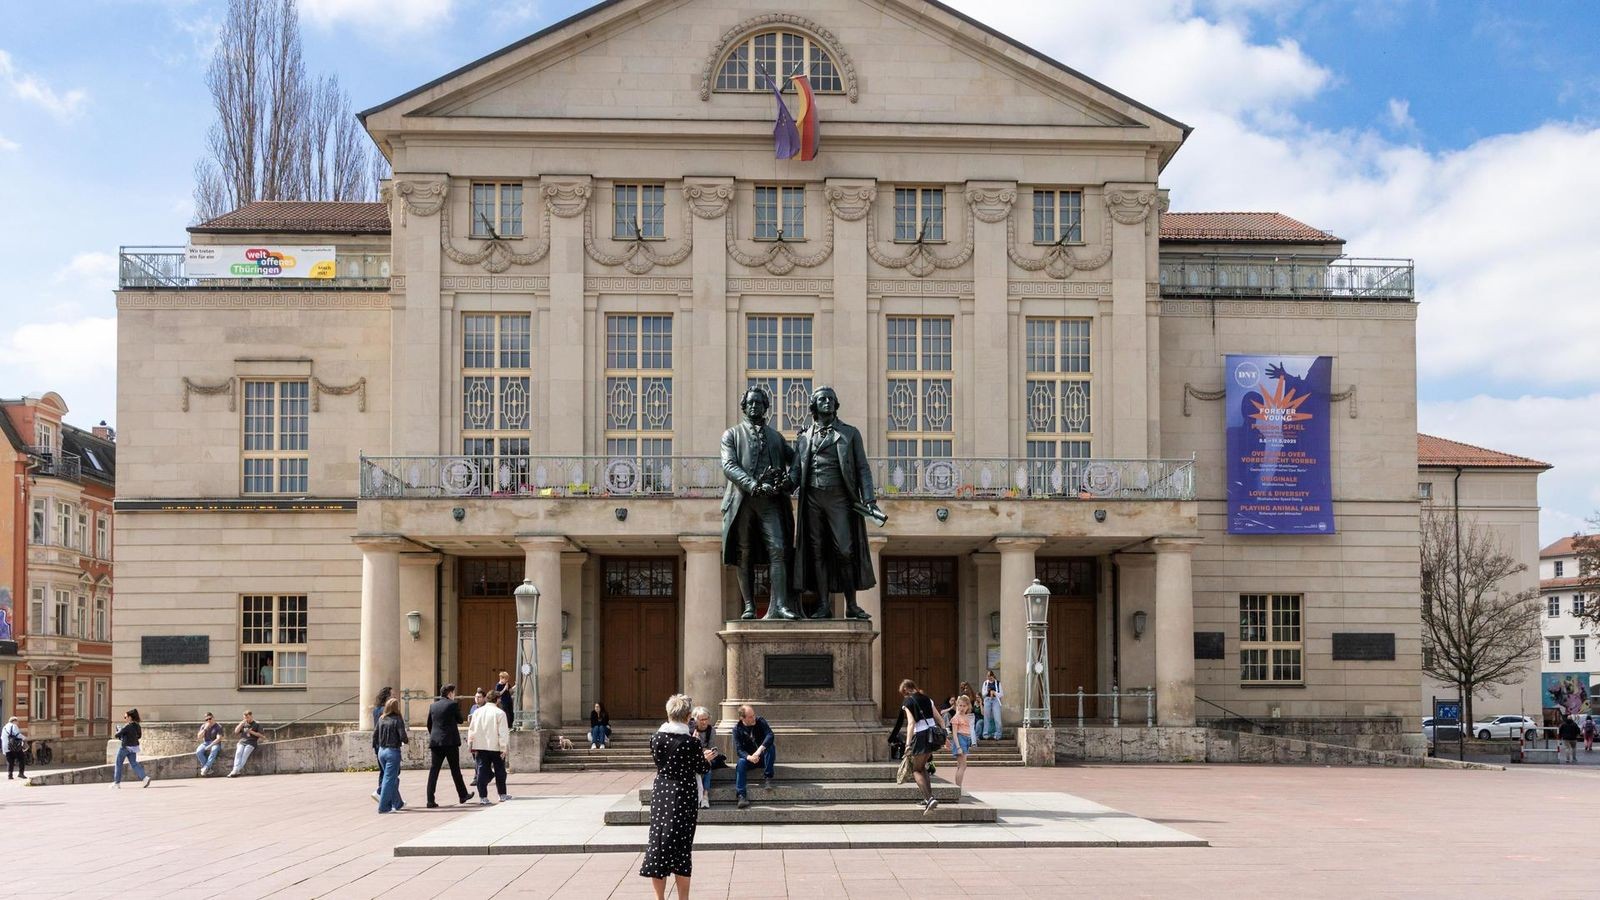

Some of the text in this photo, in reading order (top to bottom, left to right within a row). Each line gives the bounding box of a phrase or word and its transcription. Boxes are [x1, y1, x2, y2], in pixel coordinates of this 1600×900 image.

[261, 258, 294, 266] offenes
[233, 265, 279, 274] Thüringen
[1238, 371, 1257, 379] DNT
